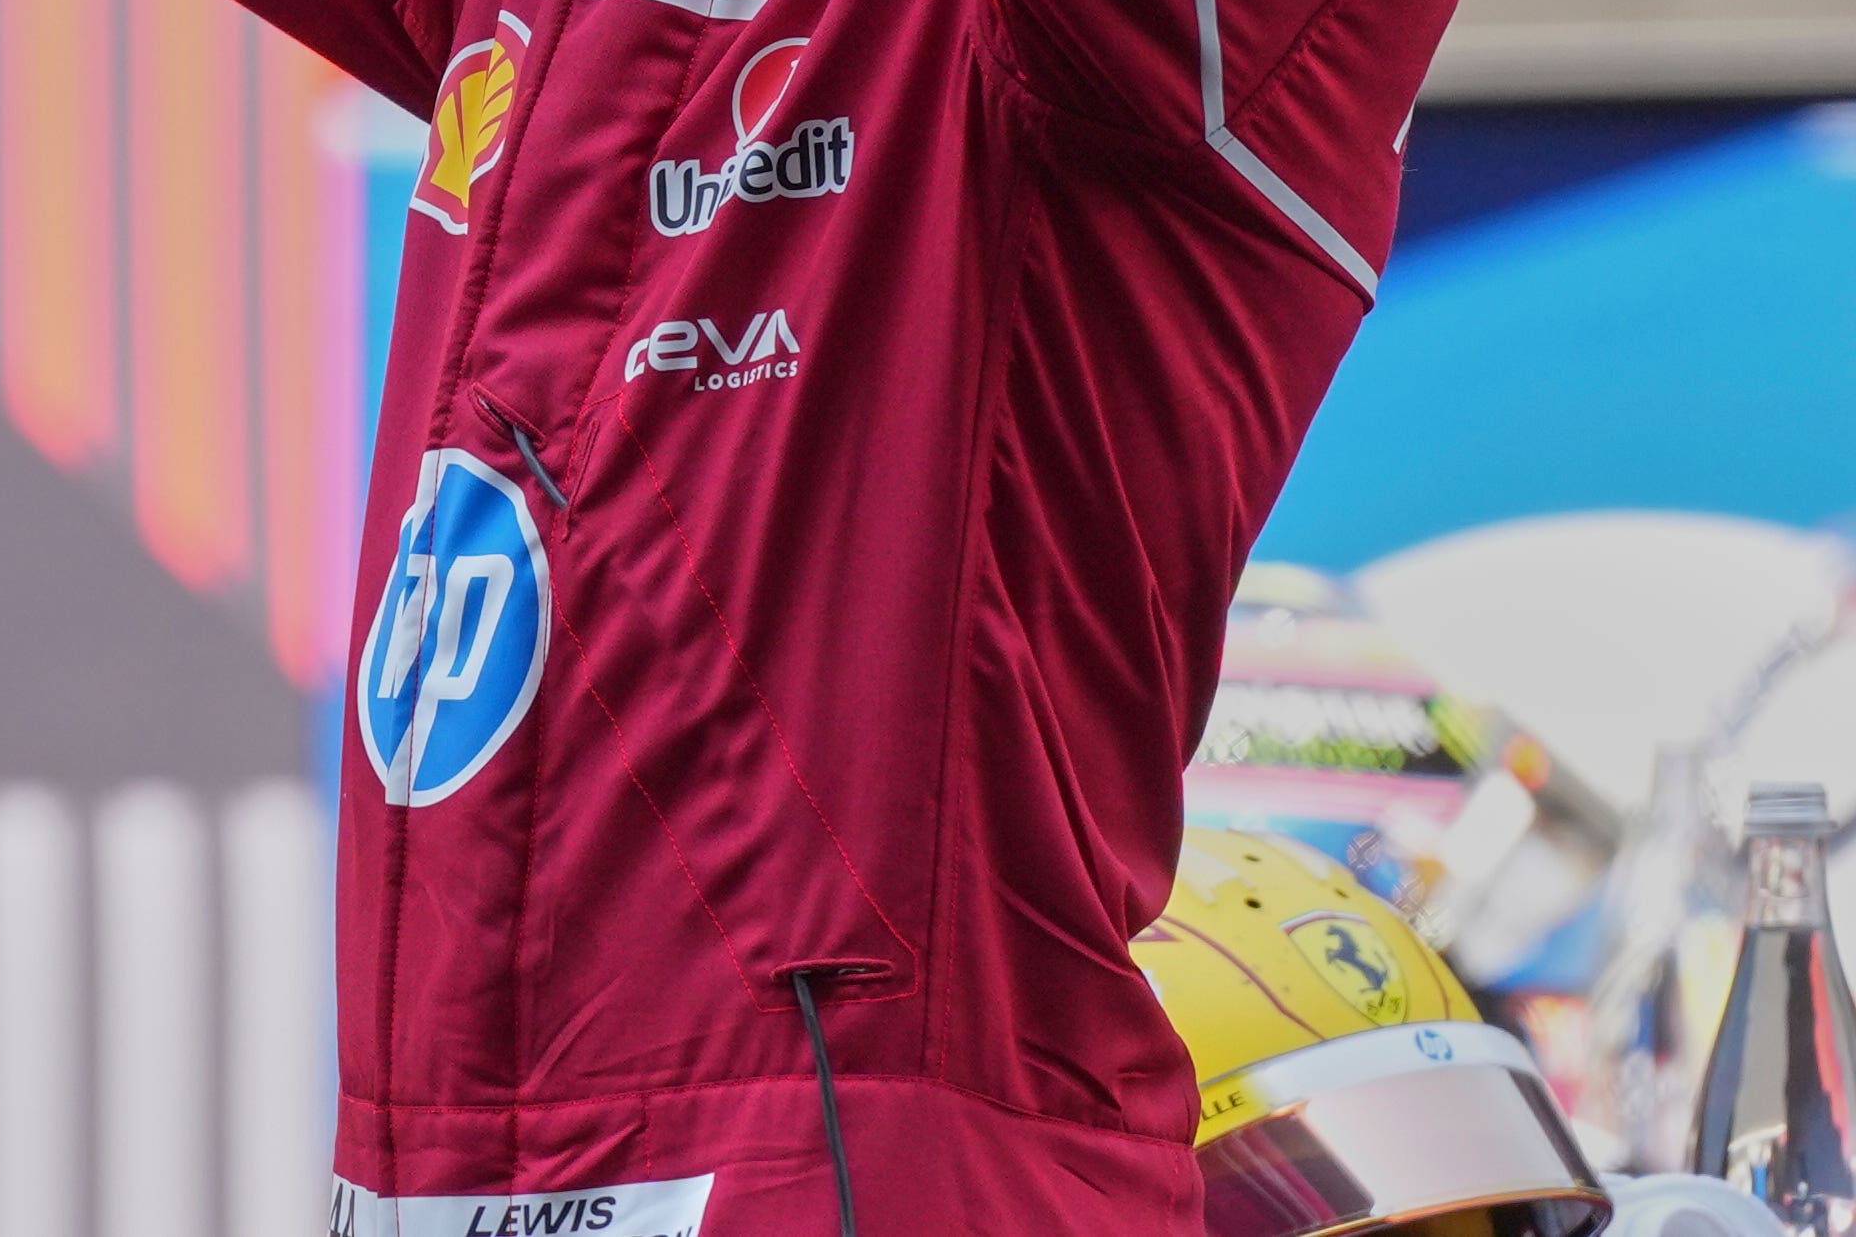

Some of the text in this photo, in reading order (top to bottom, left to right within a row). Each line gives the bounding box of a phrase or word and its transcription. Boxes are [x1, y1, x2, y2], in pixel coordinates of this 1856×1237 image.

[654, 123, 850, 231] Uniedit
[694, 360, 799, 392] LOGISTICS
[465, 1195, 618, 1237] LEWIS
